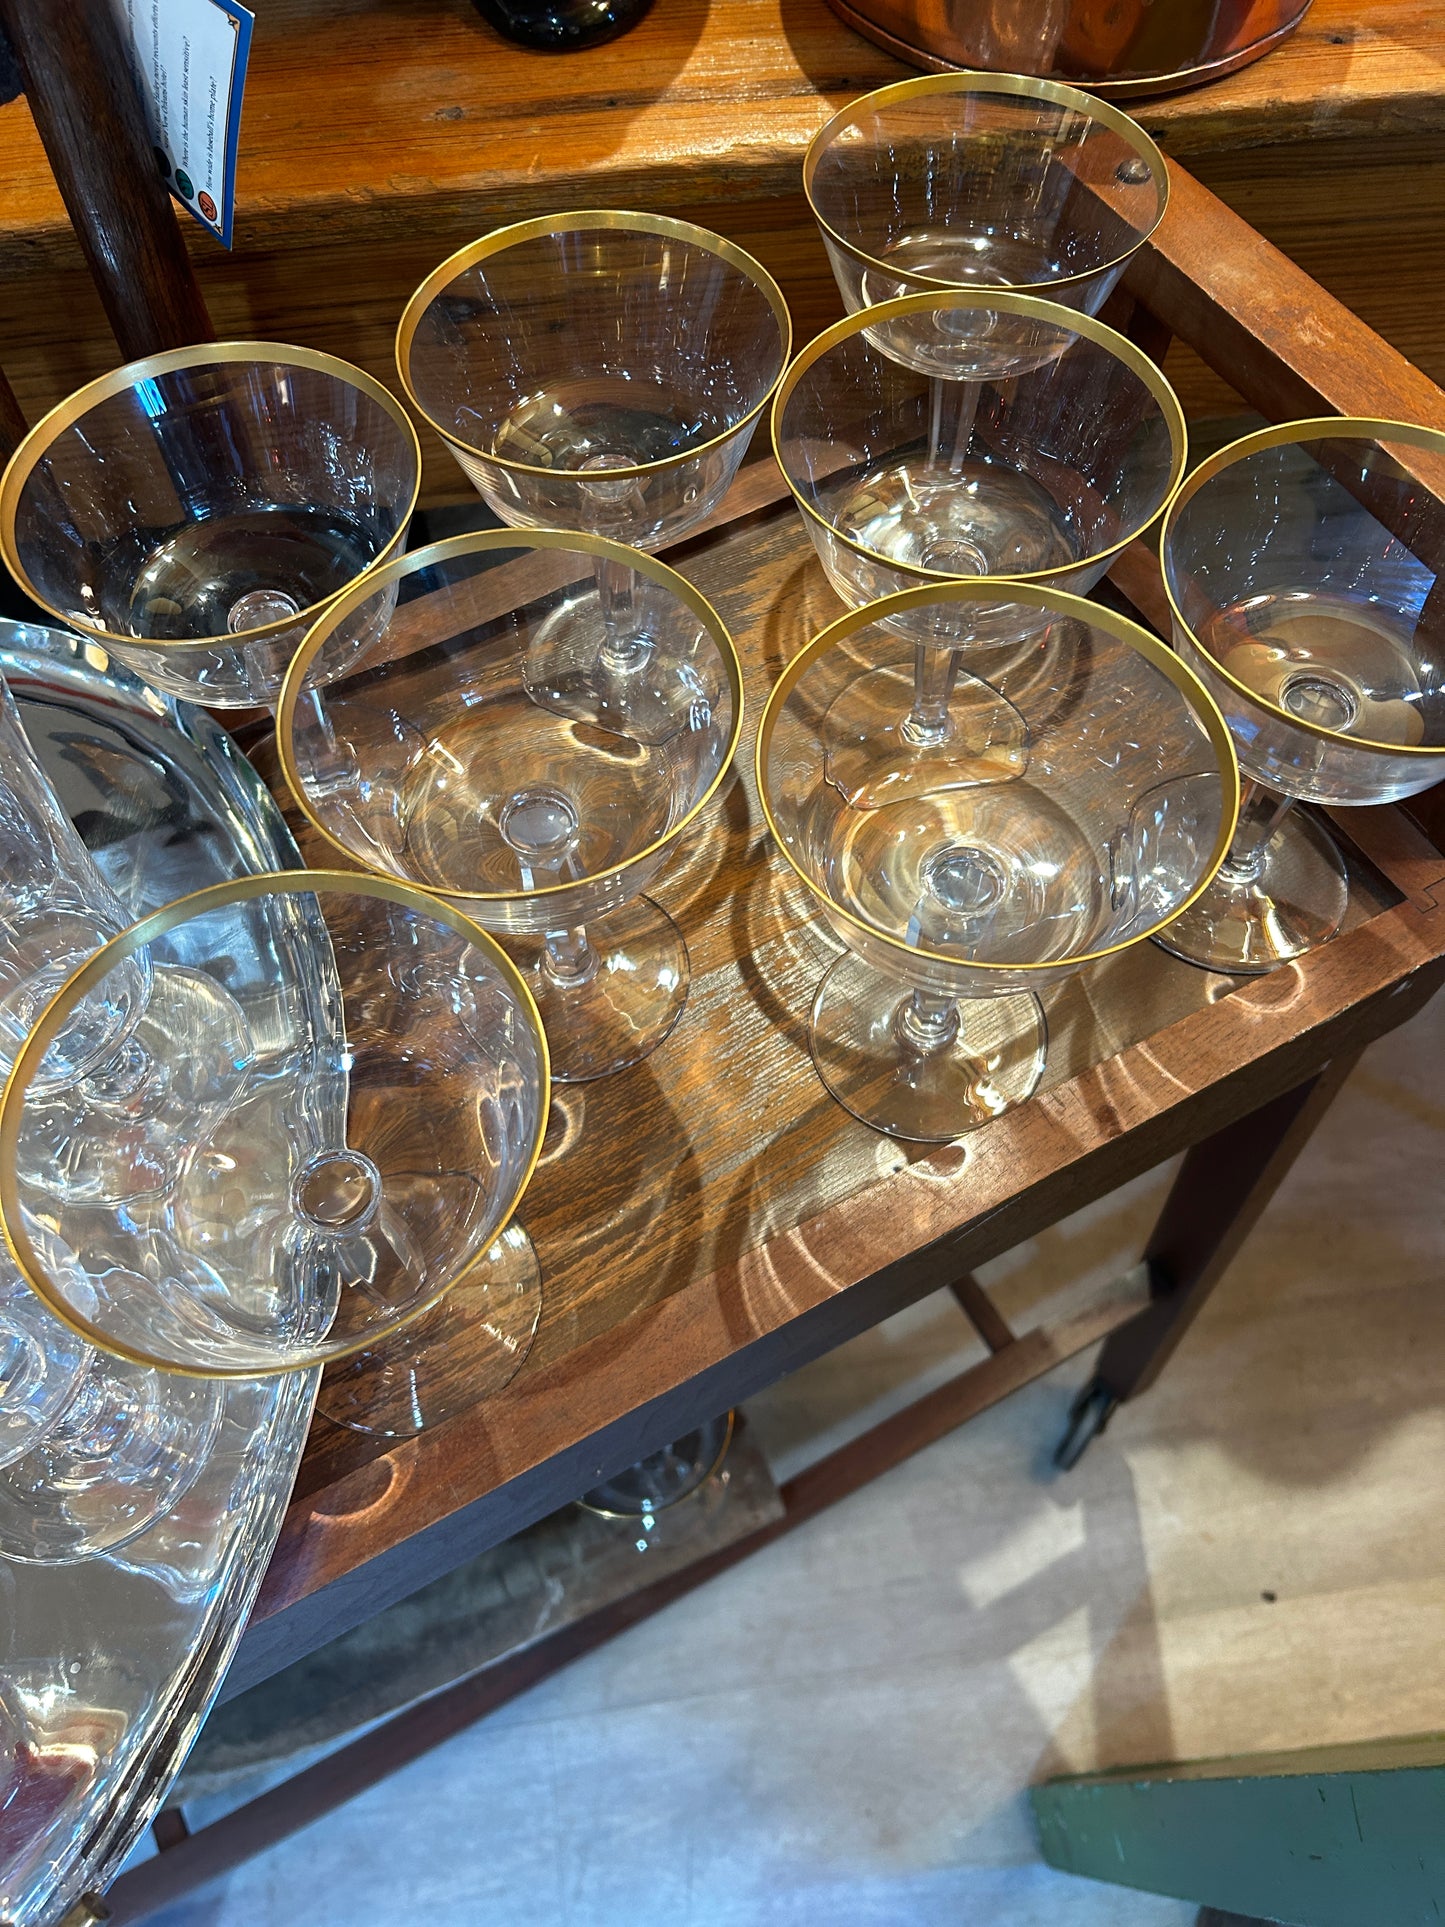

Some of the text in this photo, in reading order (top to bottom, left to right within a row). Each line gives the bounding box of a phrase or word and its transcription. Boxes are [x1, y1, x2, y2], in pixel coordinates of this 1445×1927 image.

[151, 4, 159, 29] efforts
[182, 35, 190, 74] sensitive?
[181, 91, 189, 107] skin
[209, 75, 218, 102] plate?
[181, 107, 189, 130] human
[207, 100, 215, 121] home
[161, 115, 169, 130] New
[181, 129, 189, 141] the
[206, 121, 214, 153] baseball's
